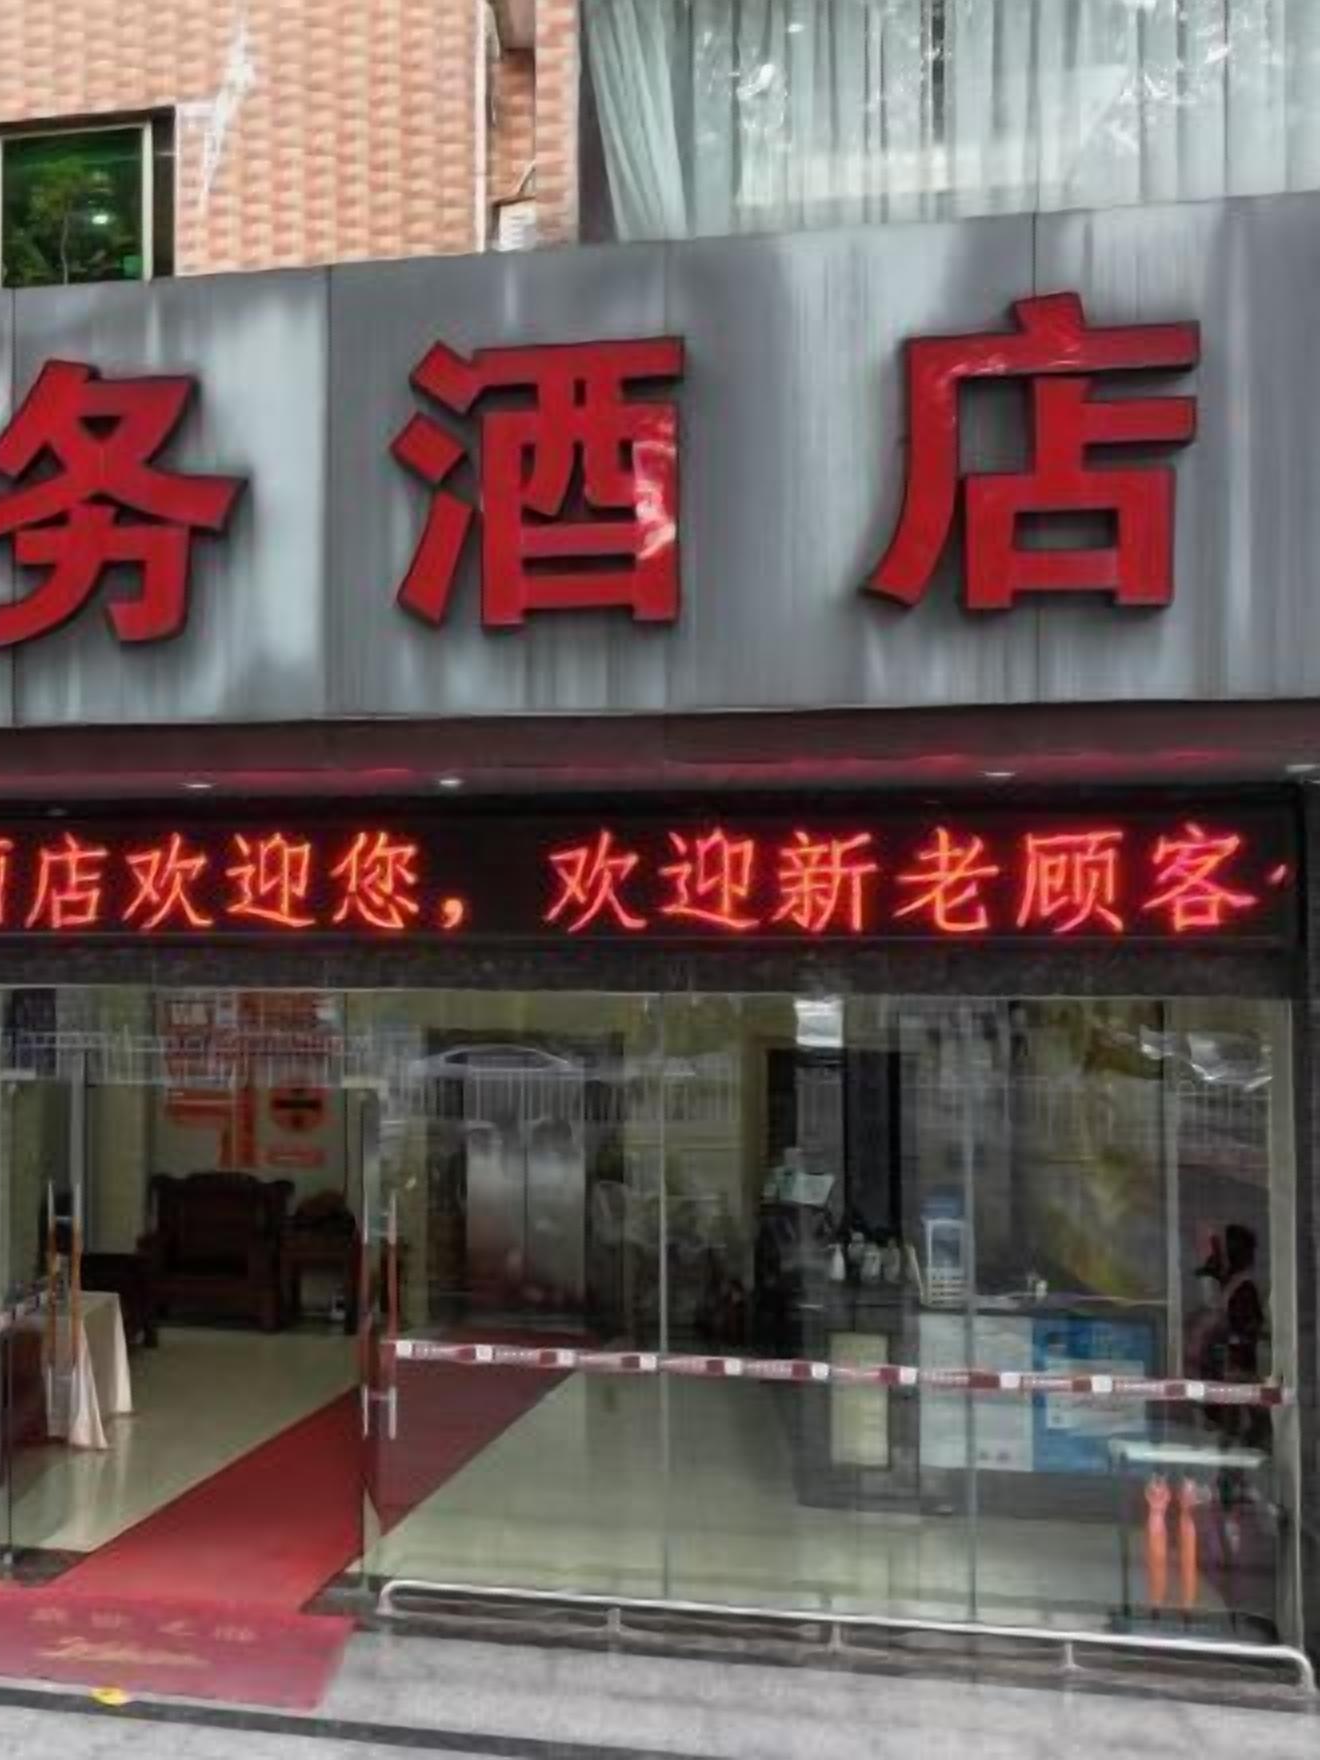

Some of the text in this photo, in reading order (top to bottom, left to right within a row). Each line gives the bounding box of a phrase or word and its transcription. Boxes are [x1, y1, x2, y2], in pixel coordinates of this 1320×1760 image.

[544, 822, 1289, 933] 欢迎新老顾客
